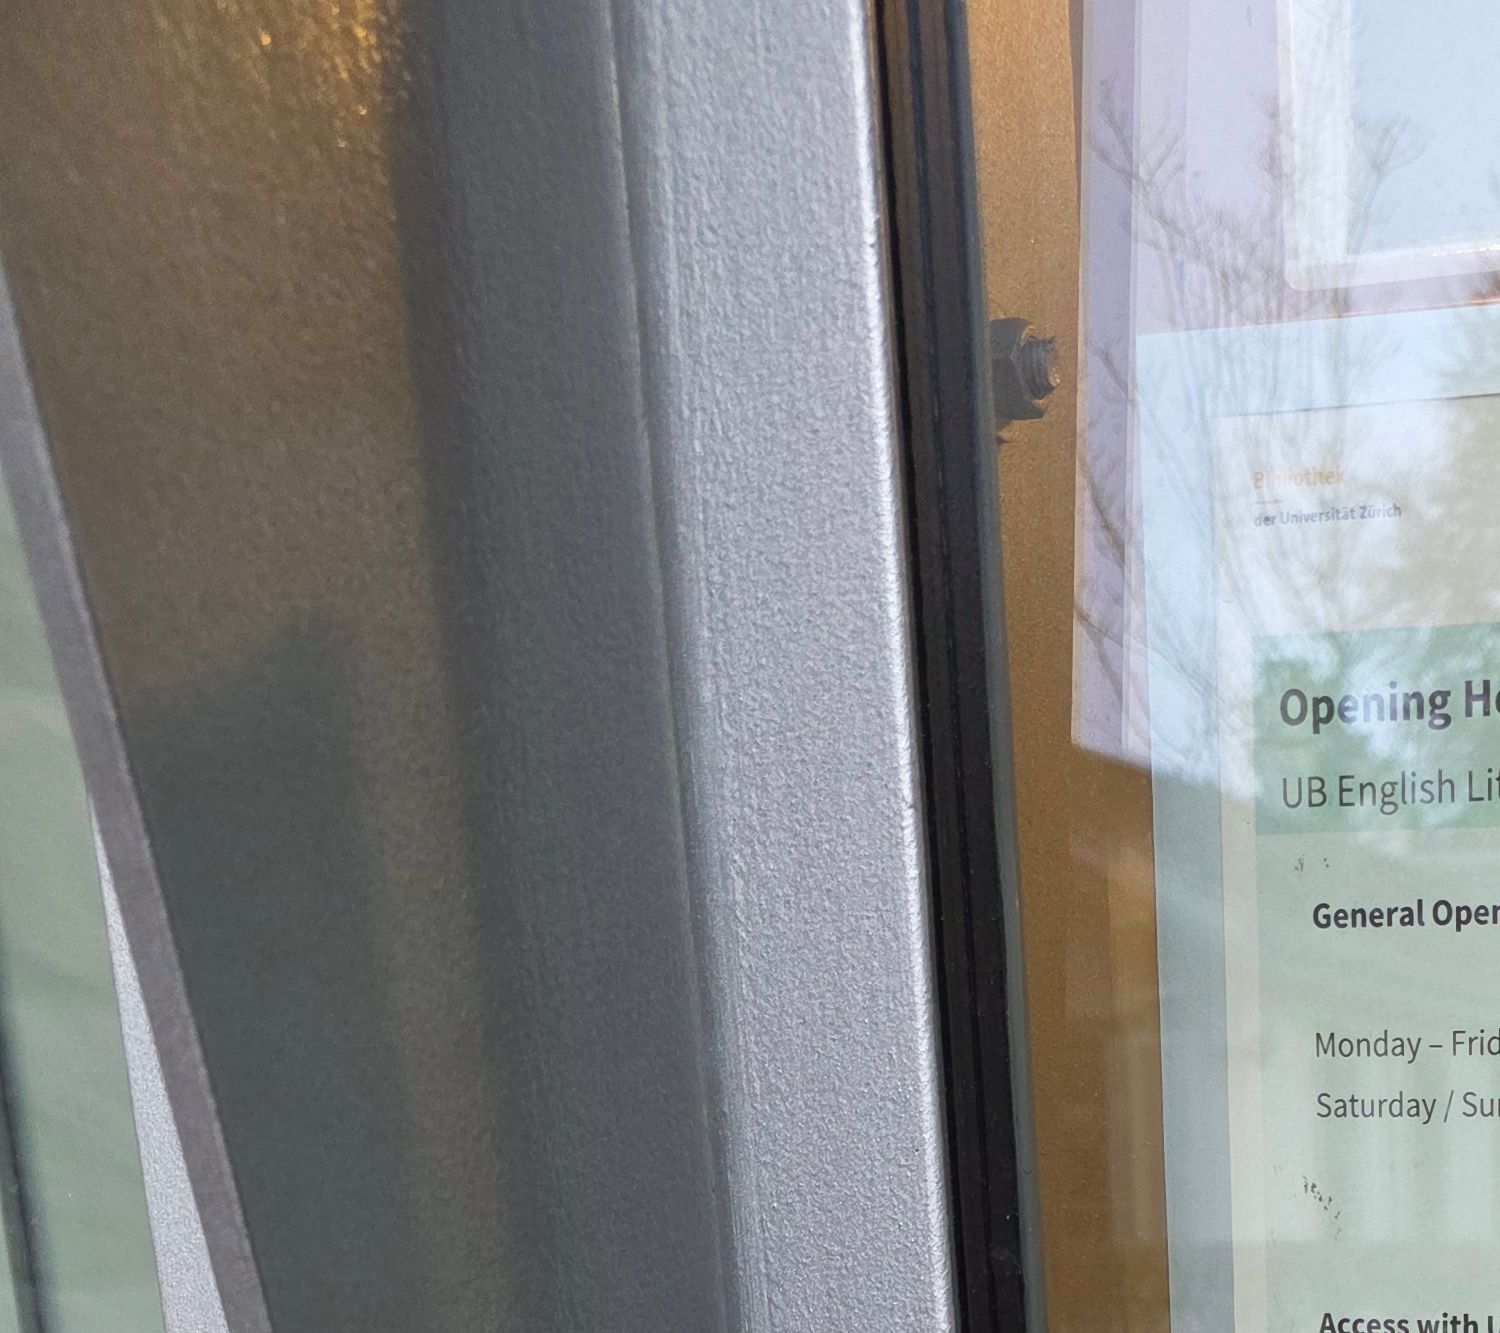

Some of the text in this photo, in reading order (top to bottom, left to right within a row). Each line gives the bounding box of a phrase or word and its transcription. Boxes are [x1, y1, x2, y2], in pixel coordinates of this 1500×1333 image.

[1254, 503, 1402, 528] der Universität Zürich
[1280, 680, 1450, 734] Opening
[1282, 775, 1328, 809] UB
[1338, 768, 1455, 816] English
[1312, 898, 1425, 929] General
[1315, 1029, 1422, 1065] Monday
[1316, 1090, 1437, 1125] Saturday
[1443, 1089, 1455, 1124] /
